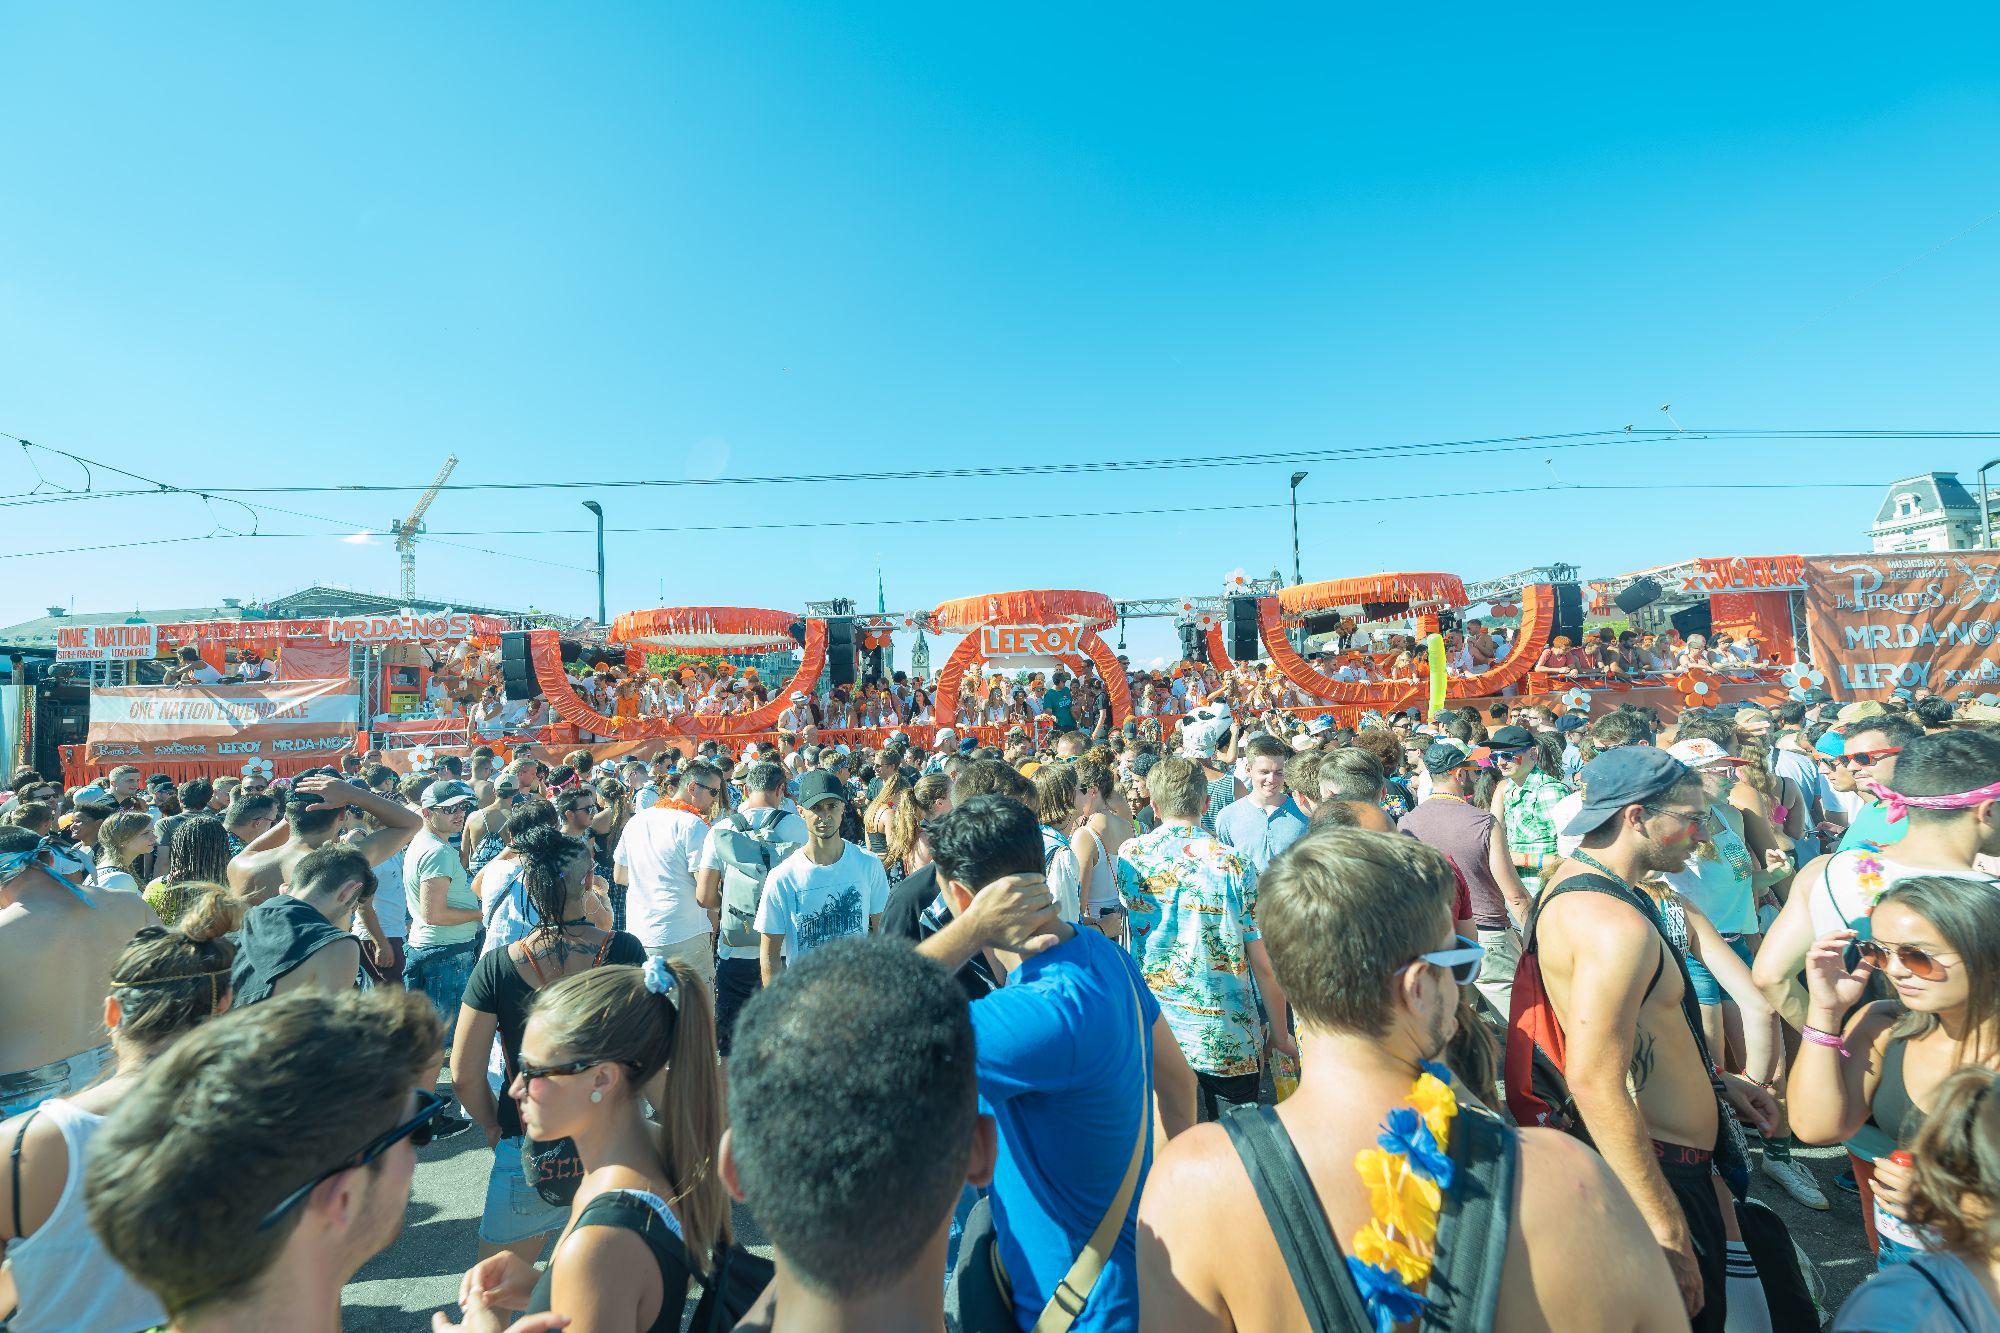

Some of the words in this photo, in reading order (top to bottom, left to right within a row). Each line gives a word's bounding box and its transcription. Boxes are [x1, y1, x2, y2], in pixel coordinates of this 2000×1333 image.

[1887, 559, 1936, 569] MUSICBAR
[1938, 558, 1947, 567] &
[1889, 568, 1950, 579] RESTAURANT
[57, 628, 89, 648] ONE
[94, 626, 151, 647] NATION
[331, 616, 468, 638] MR.DA-NOS
[1844, 619, 2000, 650] MR.DA-NO
[983, 626, 1080, 653] LEEROY
[1839, 661, 1932, 690] LEEROY
[129, 701, 158, 720] ONE
[158, 701, 214, 720] NATION
[217, 741, 261, 754] LEEROY
[272, 737, 352, 753] MR.DA-NOS
